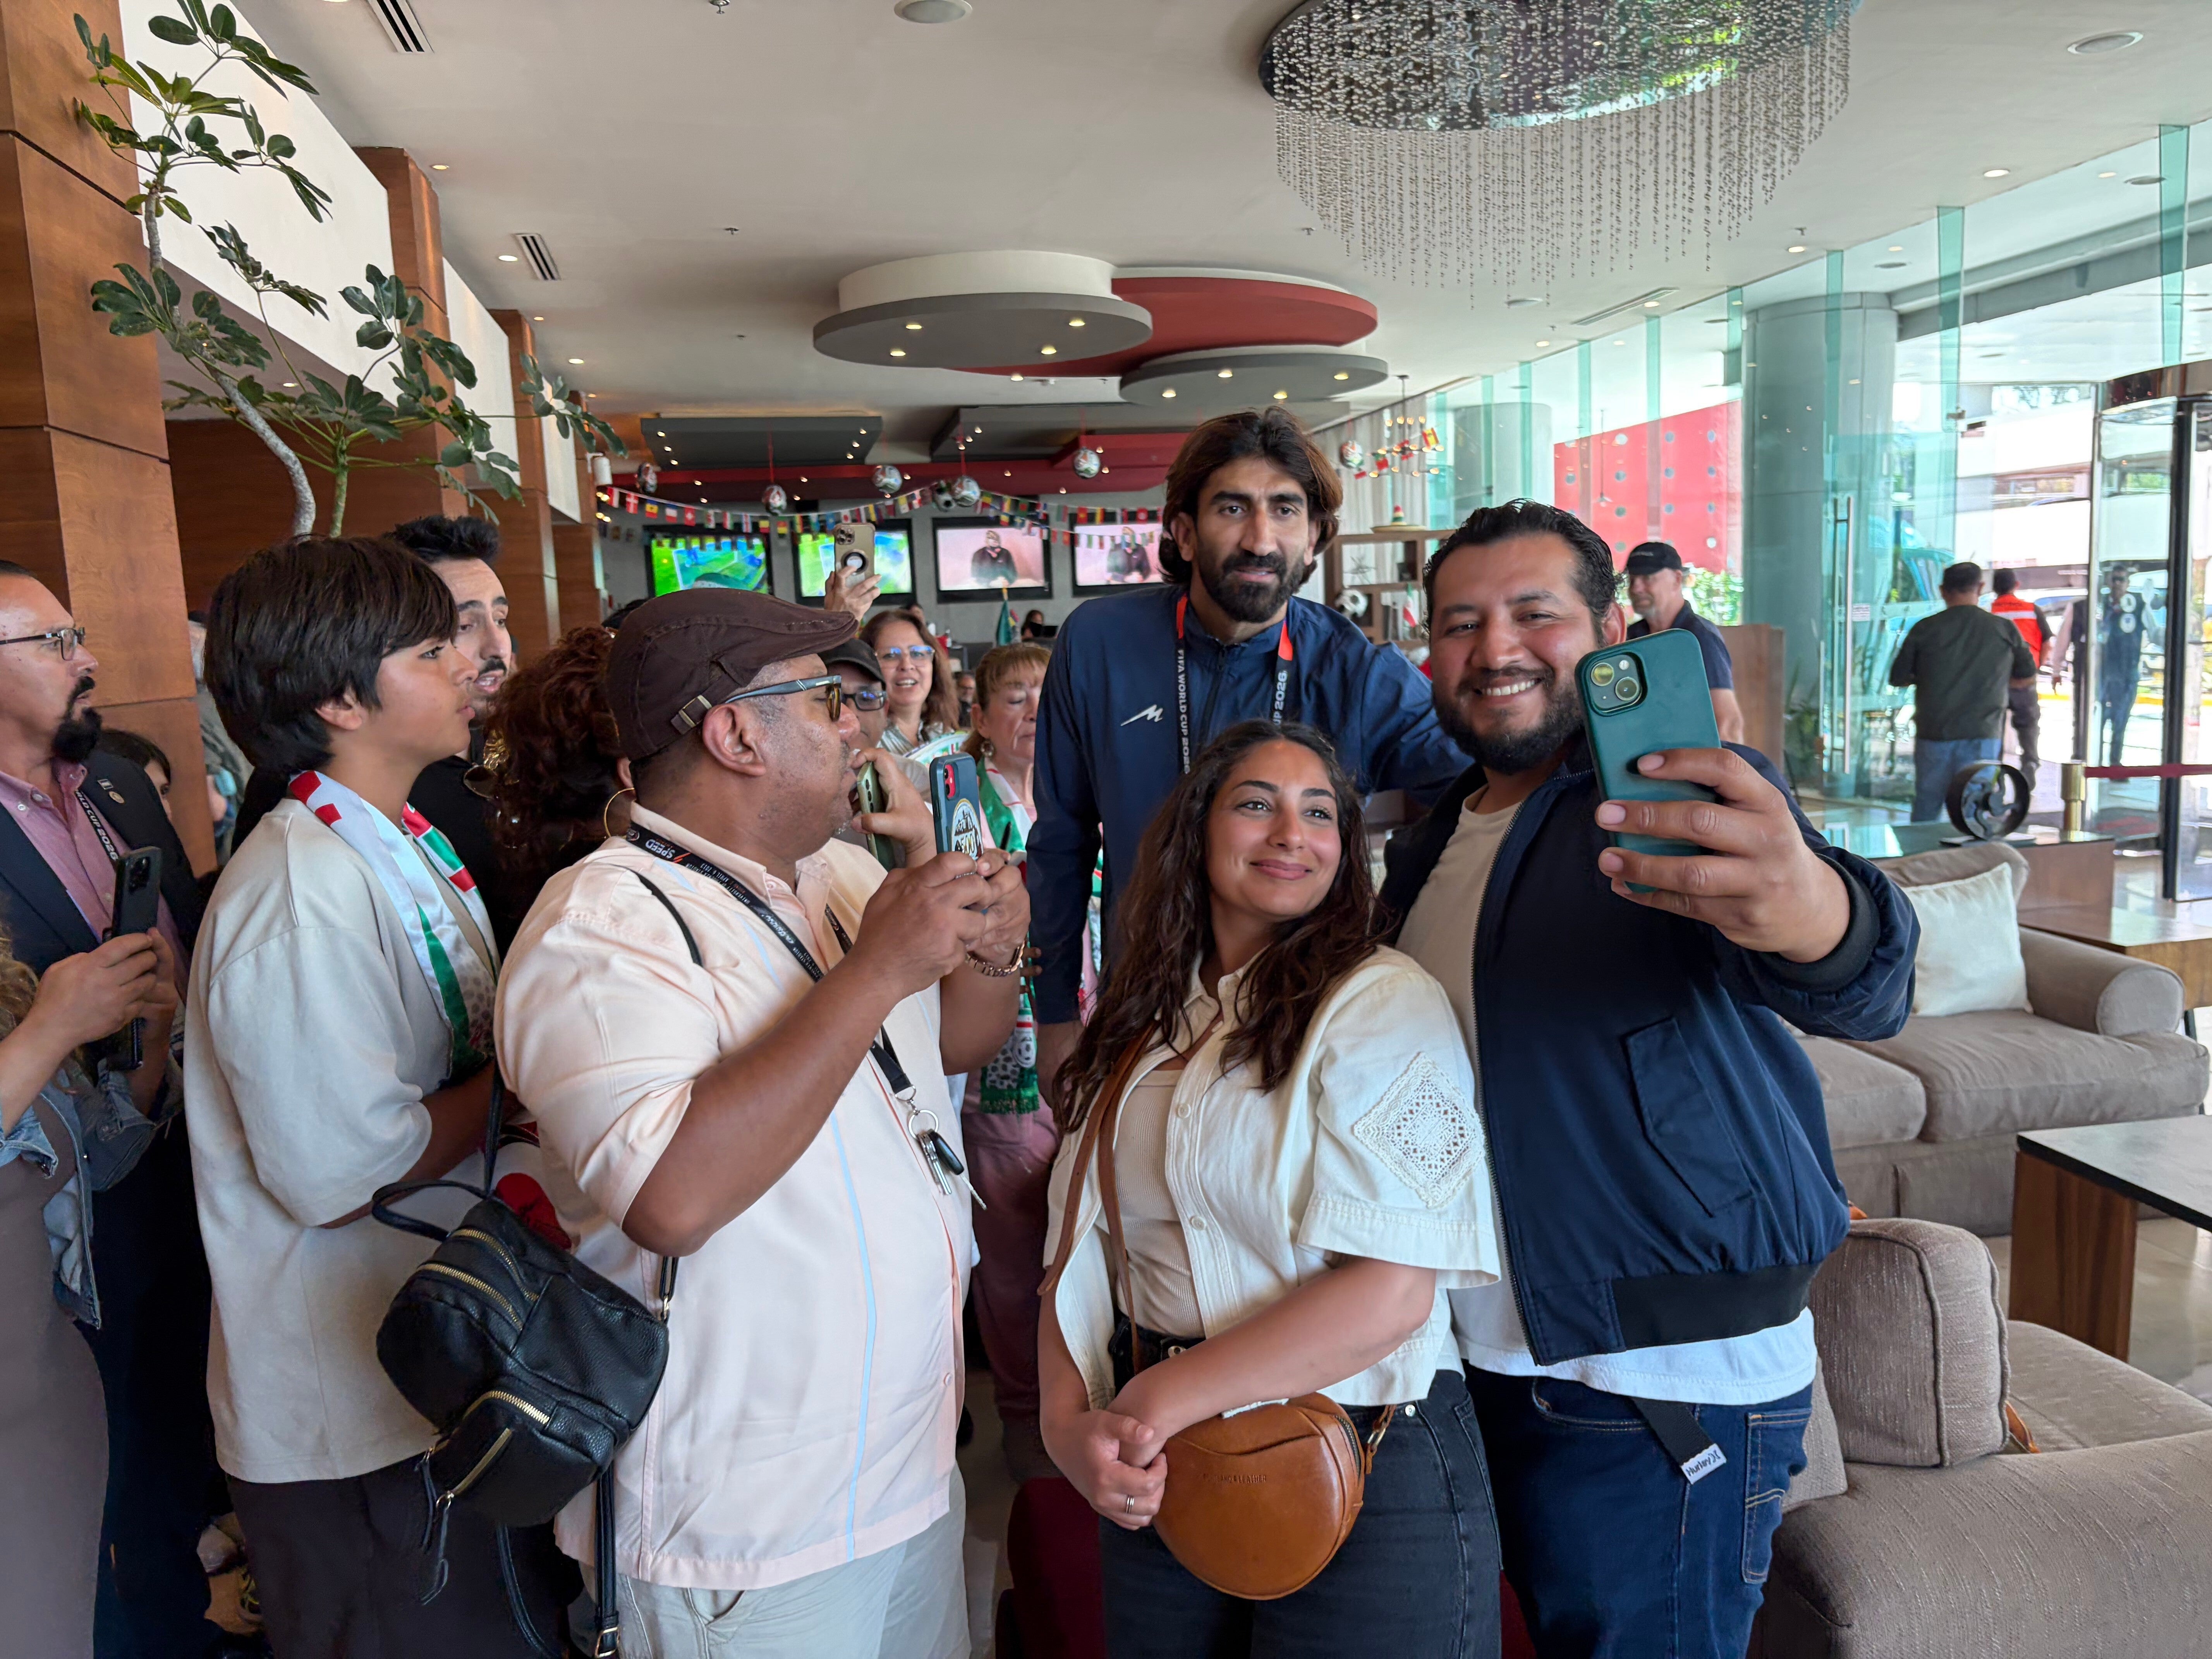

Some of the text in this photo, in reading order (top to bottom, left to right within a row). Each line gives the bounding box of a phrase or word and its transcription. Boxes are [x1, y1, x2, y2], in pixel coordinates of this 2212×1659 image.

[1178, 674, 1187, 713] WORLD
[1273, 672, 1288, 725] UP 2026
[76, 791, 118, 861] RLD CUP 2026
[645, 839, 675, 859] SPEED
[1686, 1456, 1711, 1477] Hurley
